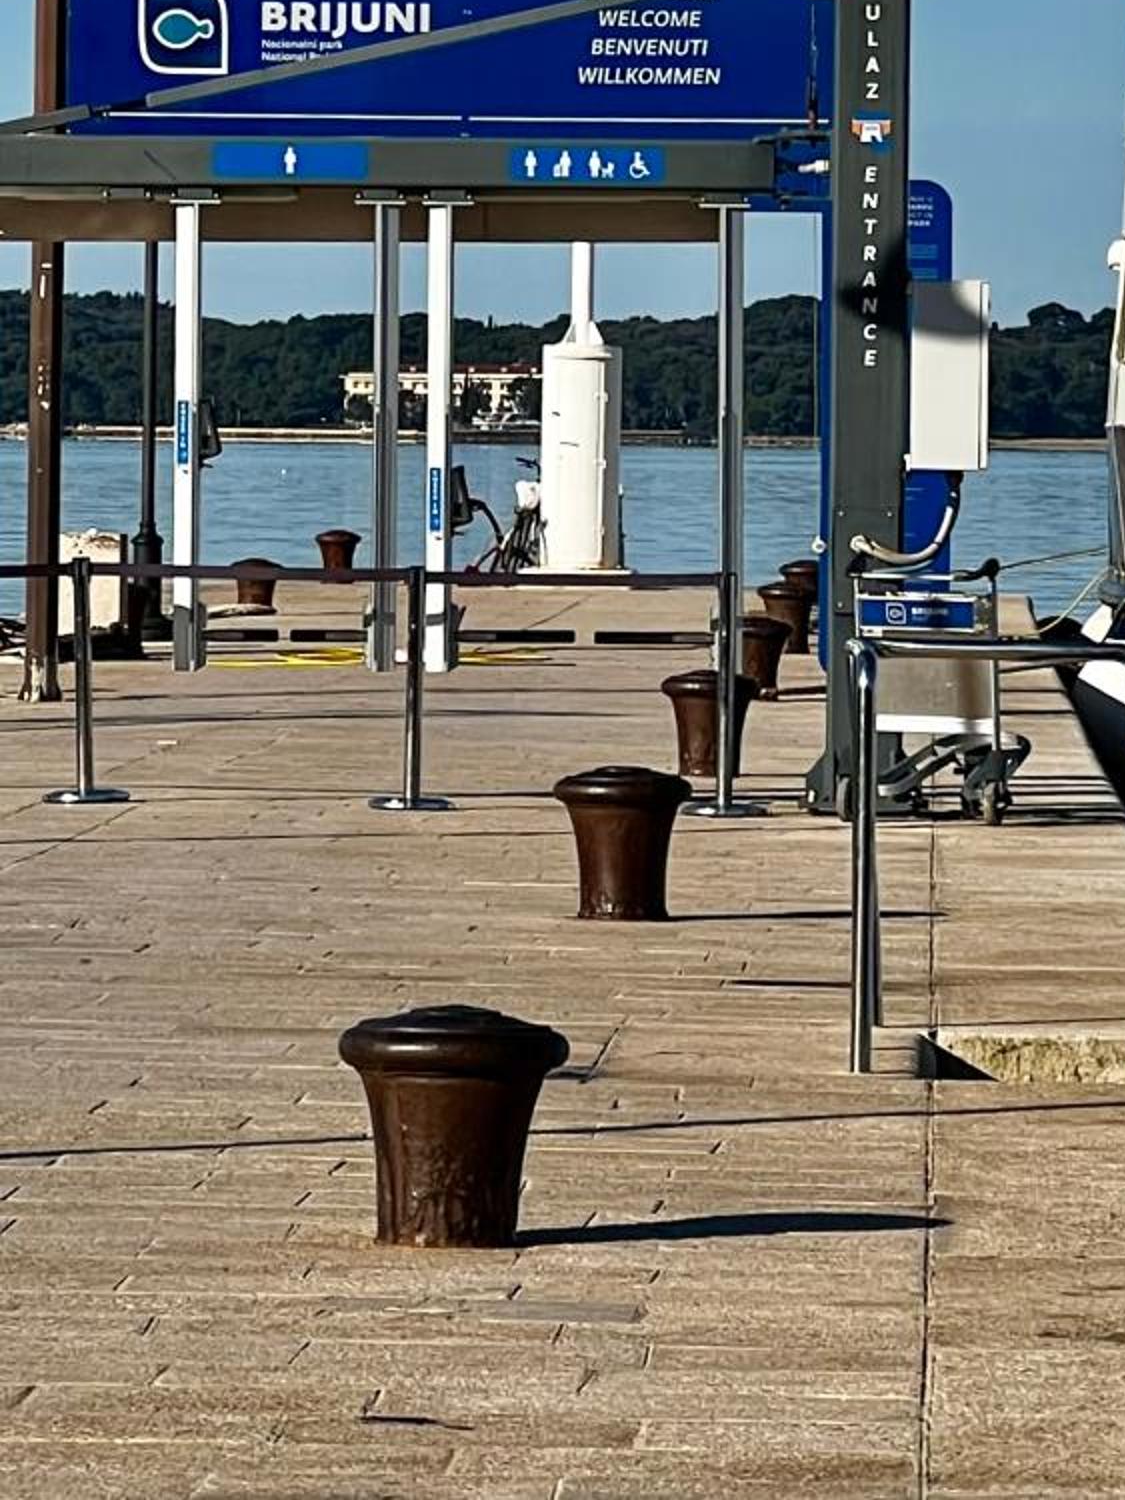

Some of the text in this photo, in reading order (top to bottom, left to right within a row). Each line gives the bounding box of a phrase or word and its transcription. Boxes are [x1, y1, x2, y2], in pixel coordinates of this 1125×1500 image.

[261, 1, 431, 38] BRIJUNI
[599, 9, 702, 27] WELCOME
[591, 38, 709, 56] BENVENUTI
[864, 3, 881, 99] ULAZ
[577, 66, 721, 85] WILLKOMMEN
[862, 165, 879, 367] ENTRANCE
